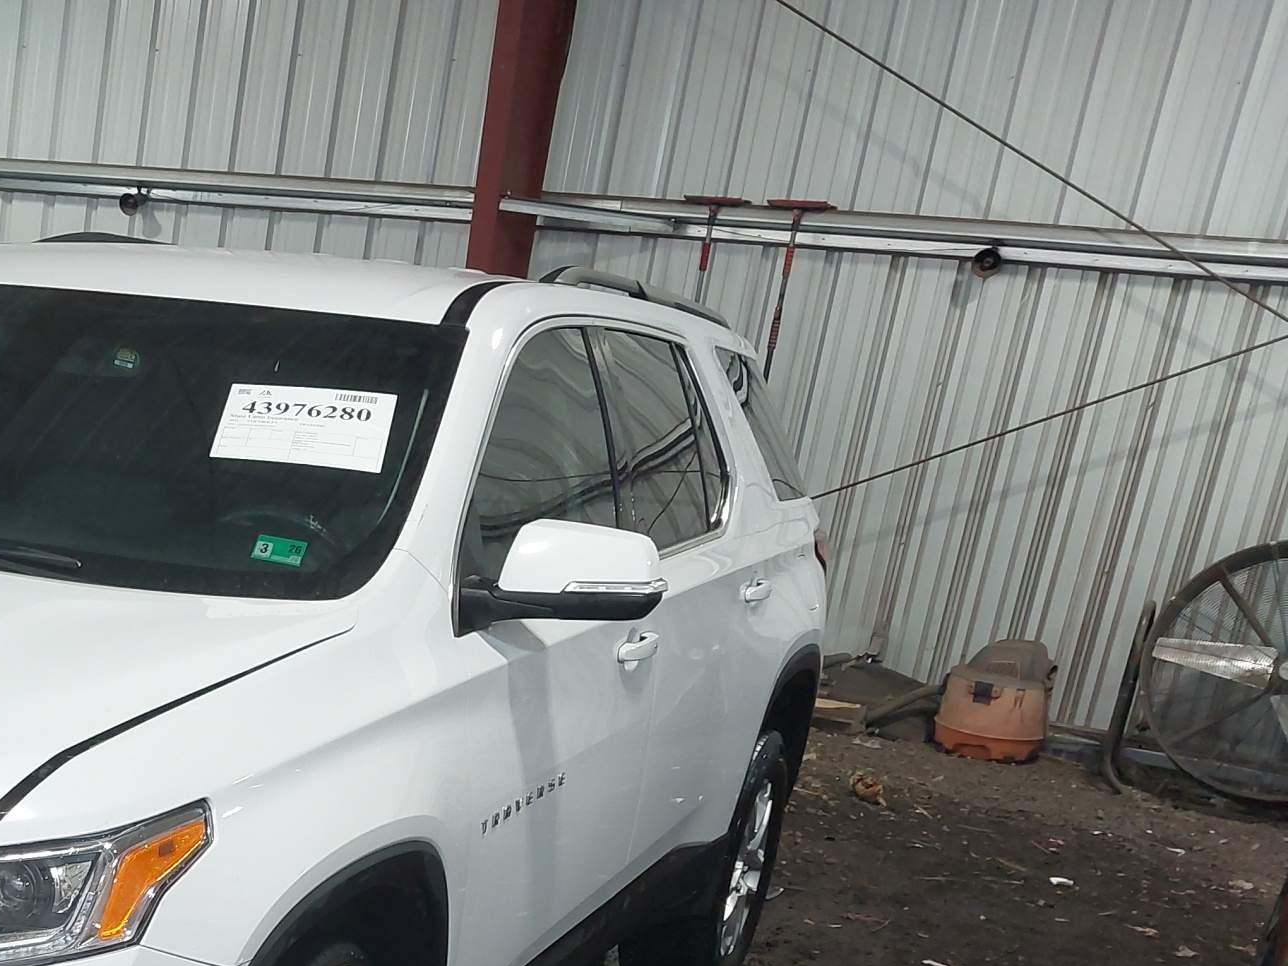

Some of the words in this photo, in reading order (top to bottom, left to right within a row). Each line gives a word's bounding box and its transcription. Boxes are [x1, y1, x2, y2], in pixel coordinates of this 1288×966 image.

[242, 401, 372, 422] 43976280
[259, 543, 269, 554] 3
[480, 772, 566, 835] TRAVERSE
